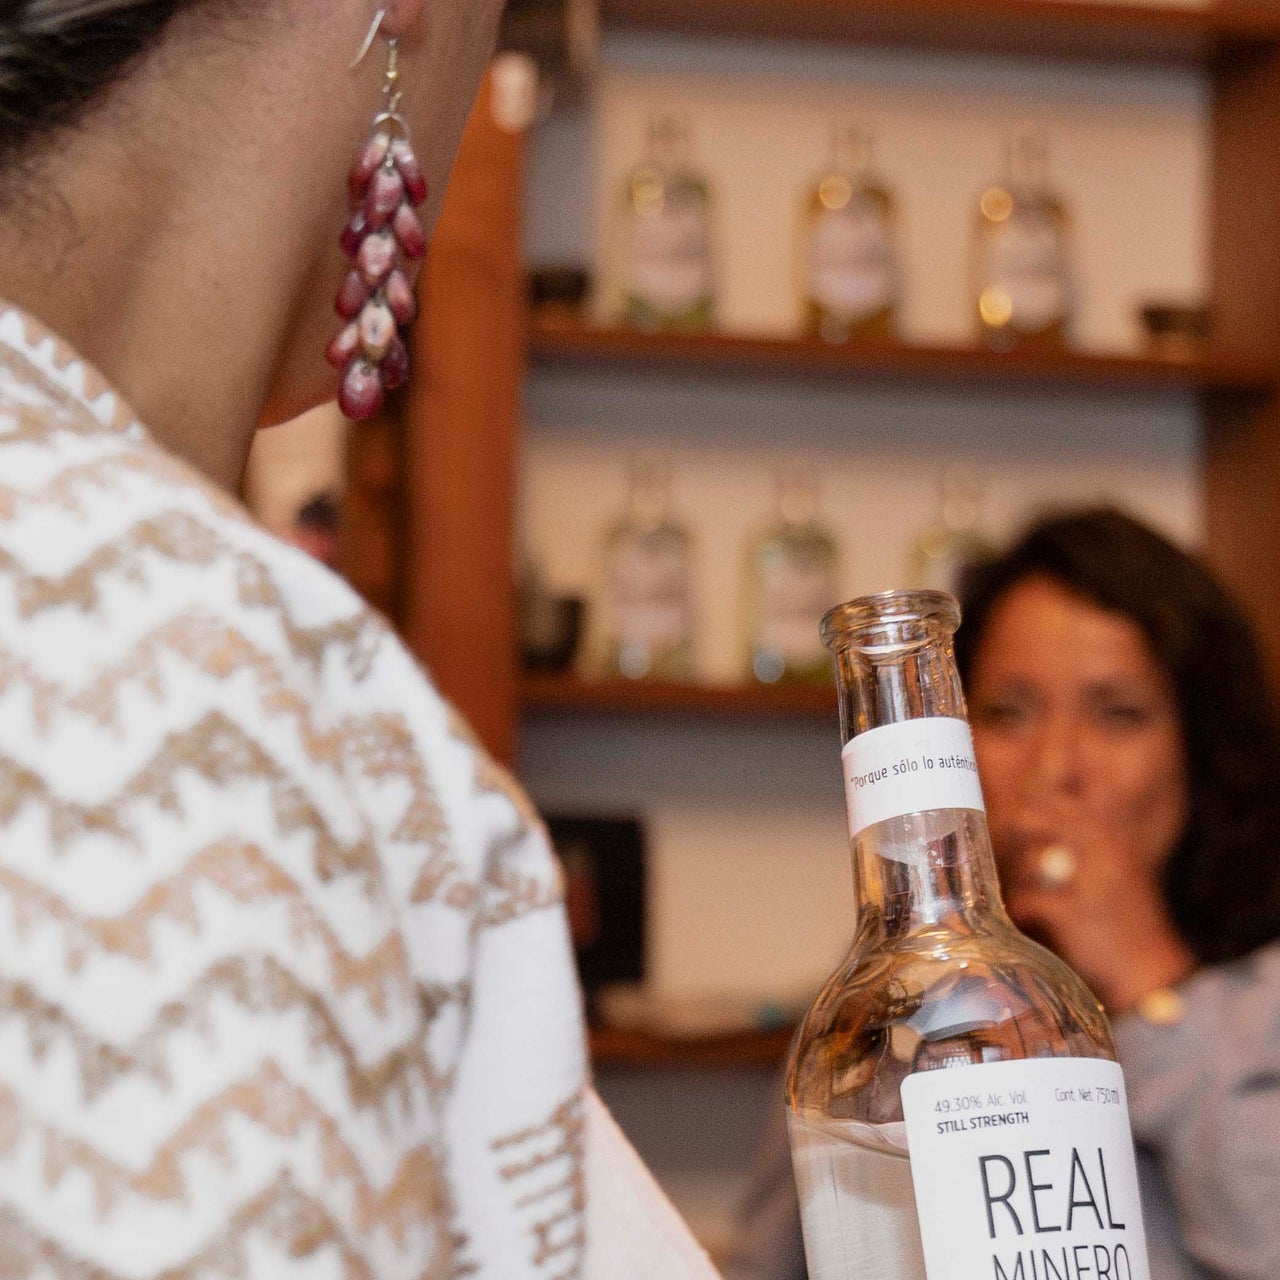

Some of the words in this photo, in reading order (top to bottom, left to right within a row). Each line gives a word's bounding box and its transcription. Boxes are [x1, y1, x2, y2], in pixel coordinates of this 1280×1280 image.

[892, 759, 919, 776] sólo
[922, 755, 934, 770] lo
[936, 1121, 968, 1135] STILL
[969, 1111, 1030, 1130] STRENGTH
[978, 1147, 1126, 1239] REAL
